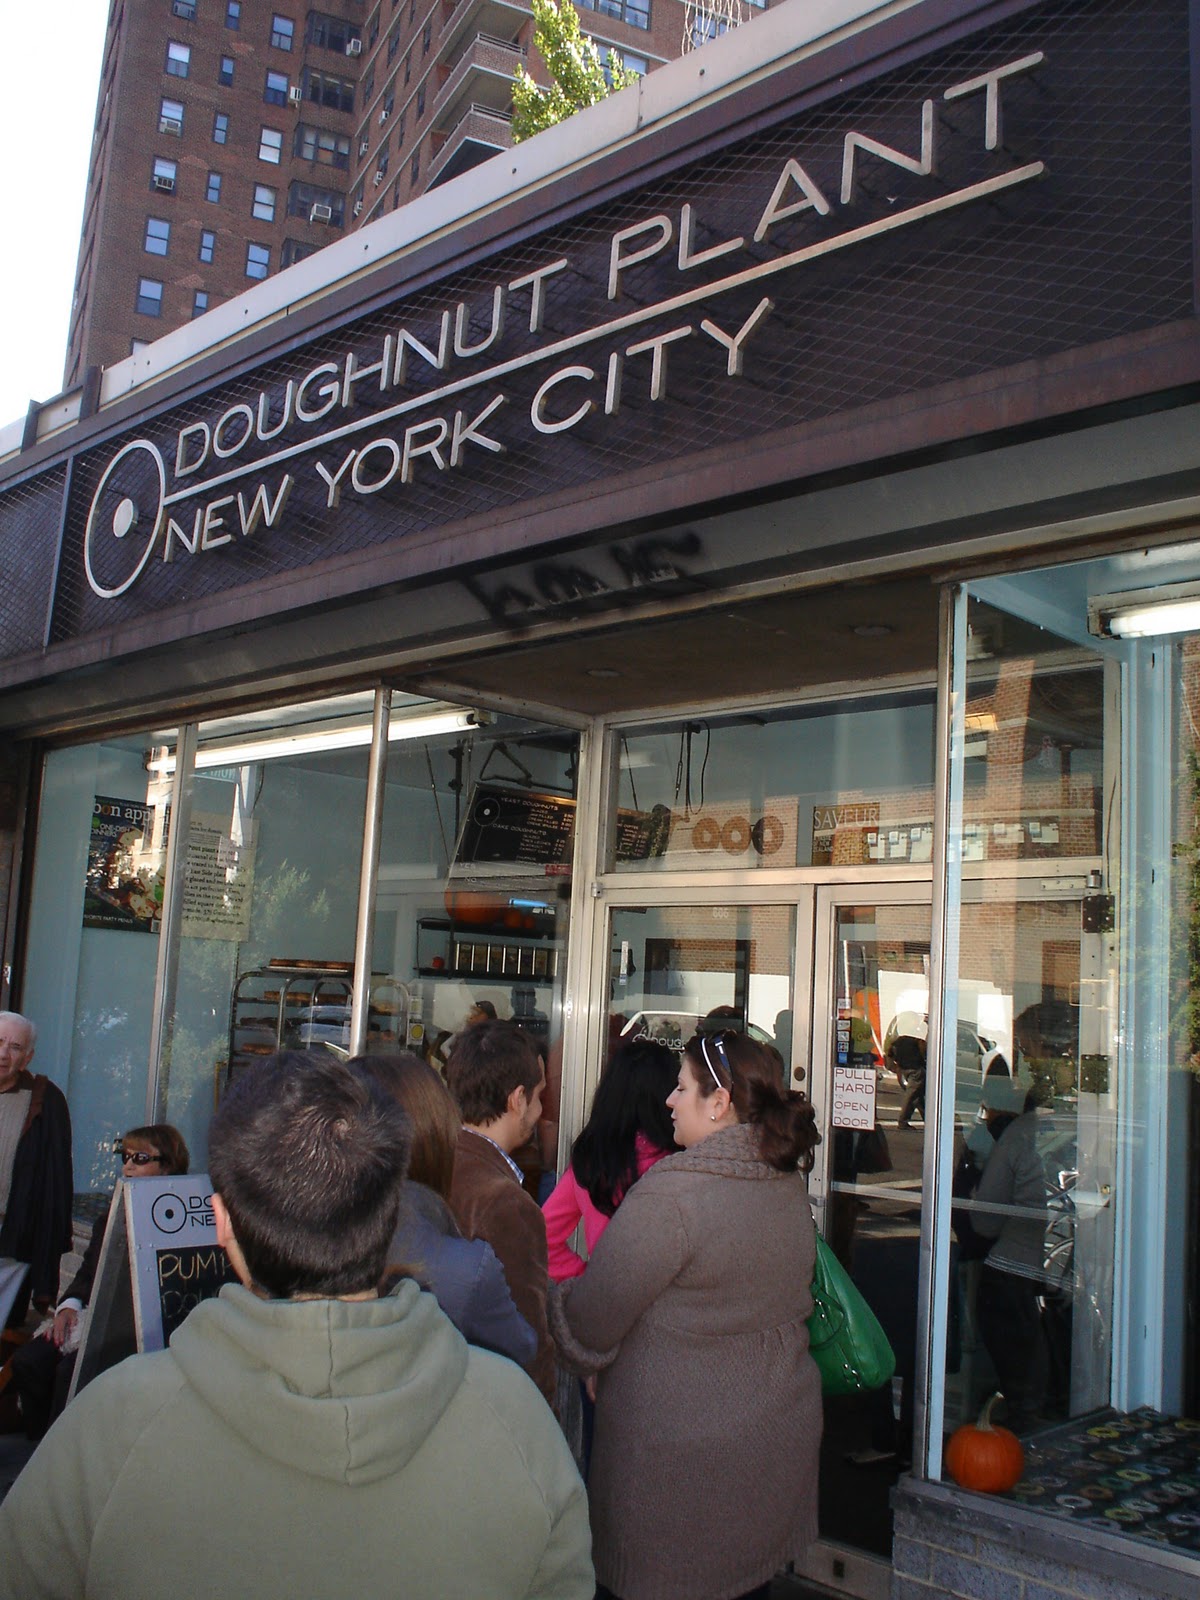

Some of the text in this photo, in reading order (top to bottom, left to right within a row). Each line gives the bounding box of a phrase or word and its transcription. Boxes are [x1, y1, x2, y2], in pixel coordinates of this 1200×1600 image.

[174, 50, 1046, 478] DOUGHNUT PLANT
[163, 296, 775, 563] NEW YORK CITY
[522, 801, 559, 812] DOUGHNUTS
[813, 807, 879, 830] SAVEUR
[510, 825, 548, 836] DOUGHNUTS
[834, 1067, 873, 1081] PULL
[834, 1081, 875, 1095] HARD
[834, 1100, 869, 1112] OPEN
[833, 1116, 870, 1128] DOOR
